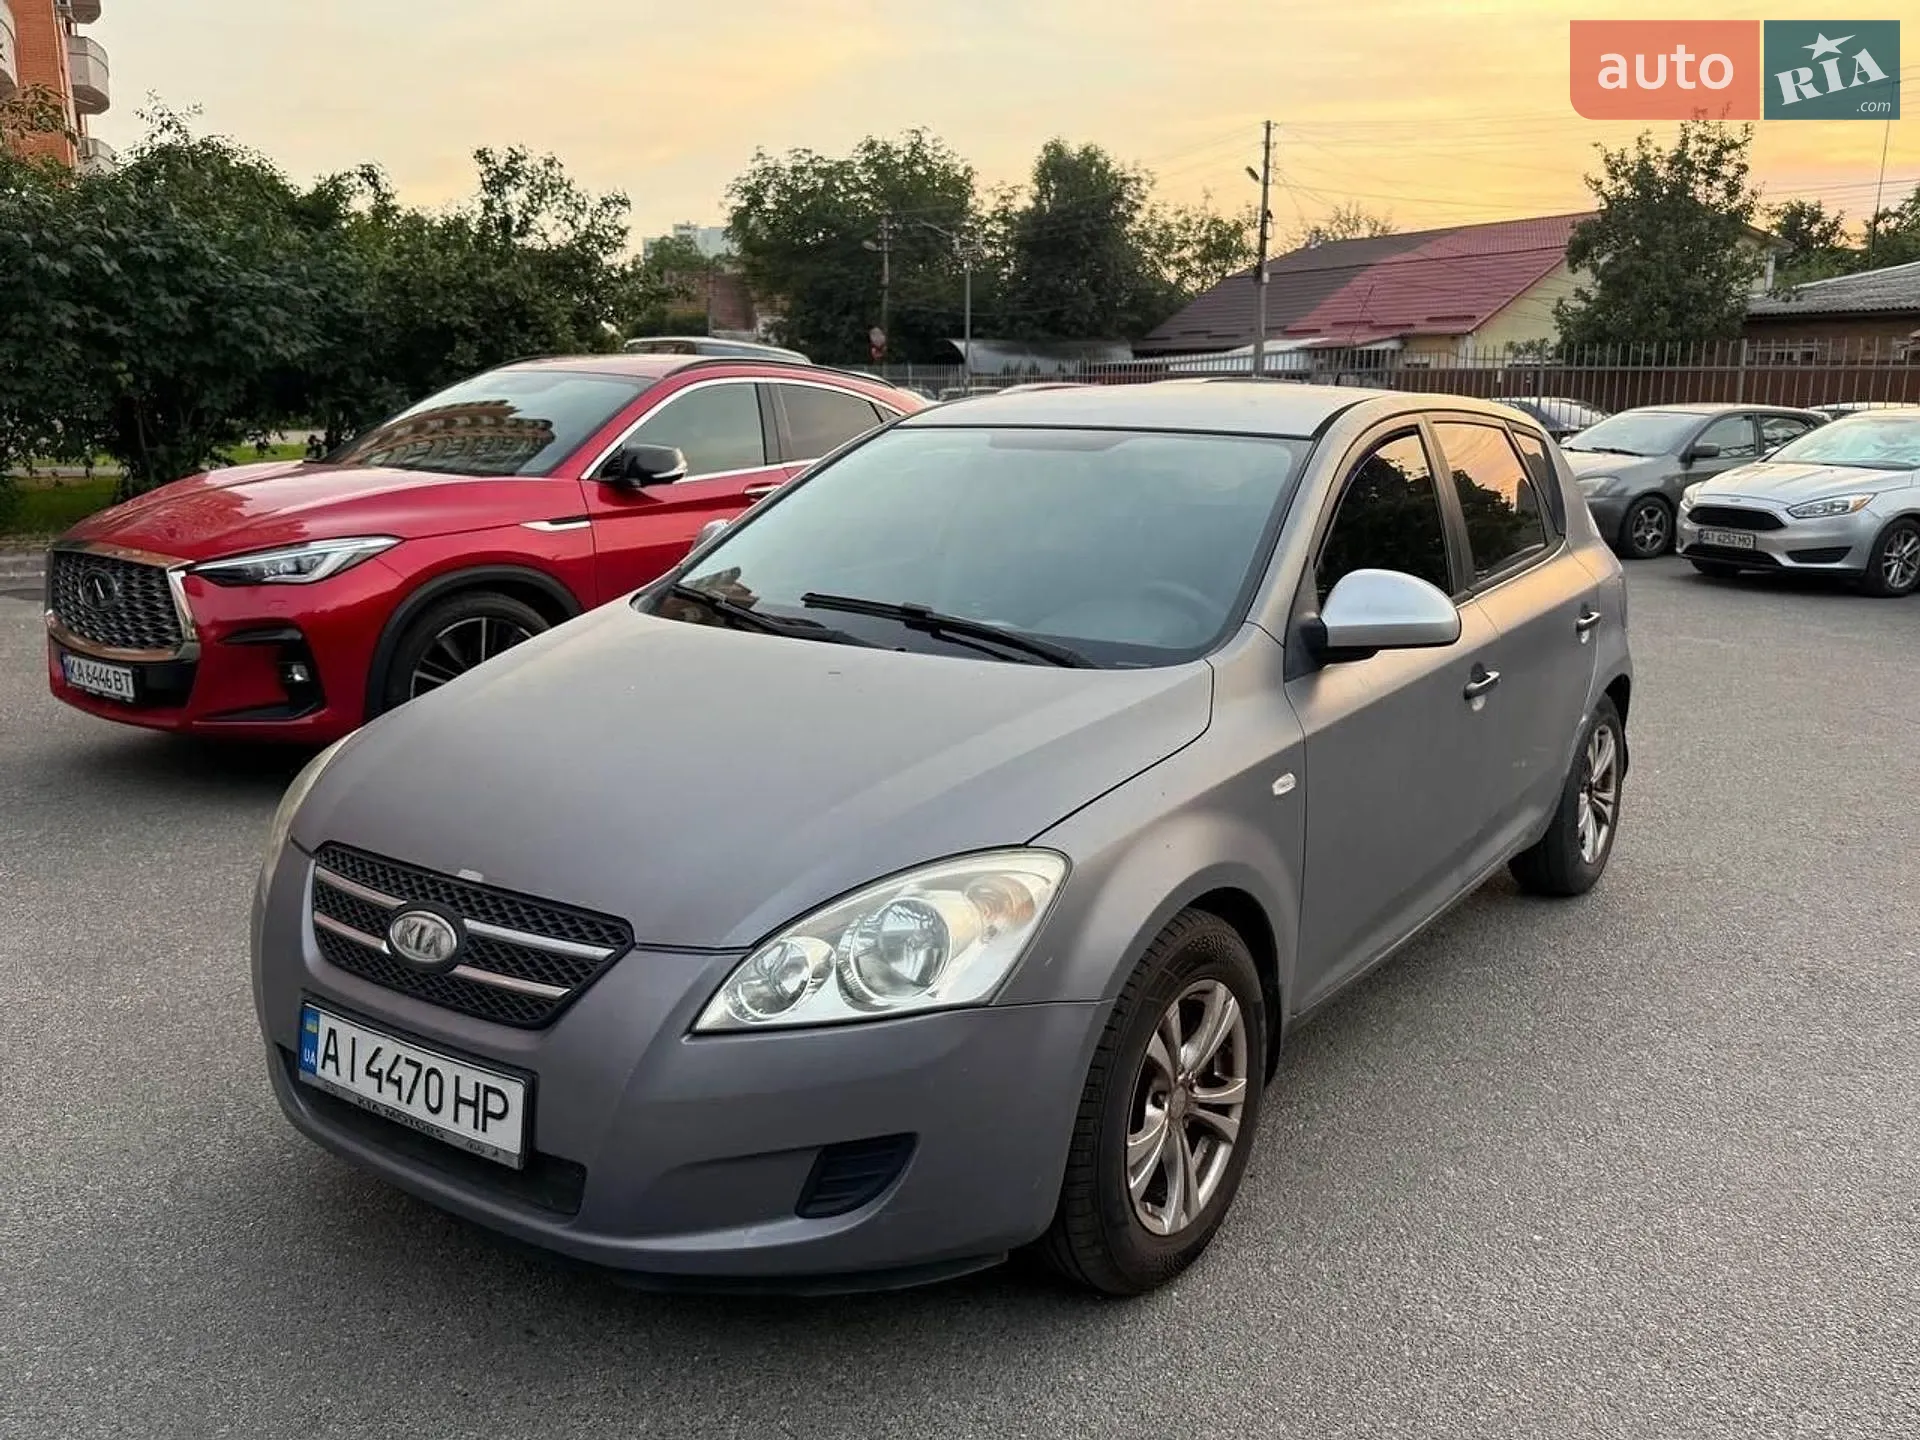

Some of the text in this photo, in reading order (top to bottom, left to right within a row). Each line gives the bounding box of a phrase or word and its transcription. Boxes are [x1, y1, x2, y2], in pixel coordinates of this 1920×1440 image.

[113, 671, 132, 694] BT
[303, 1047, 316, 1066] UA
[321, 1027, 509, 1133] AI 4470 HP
